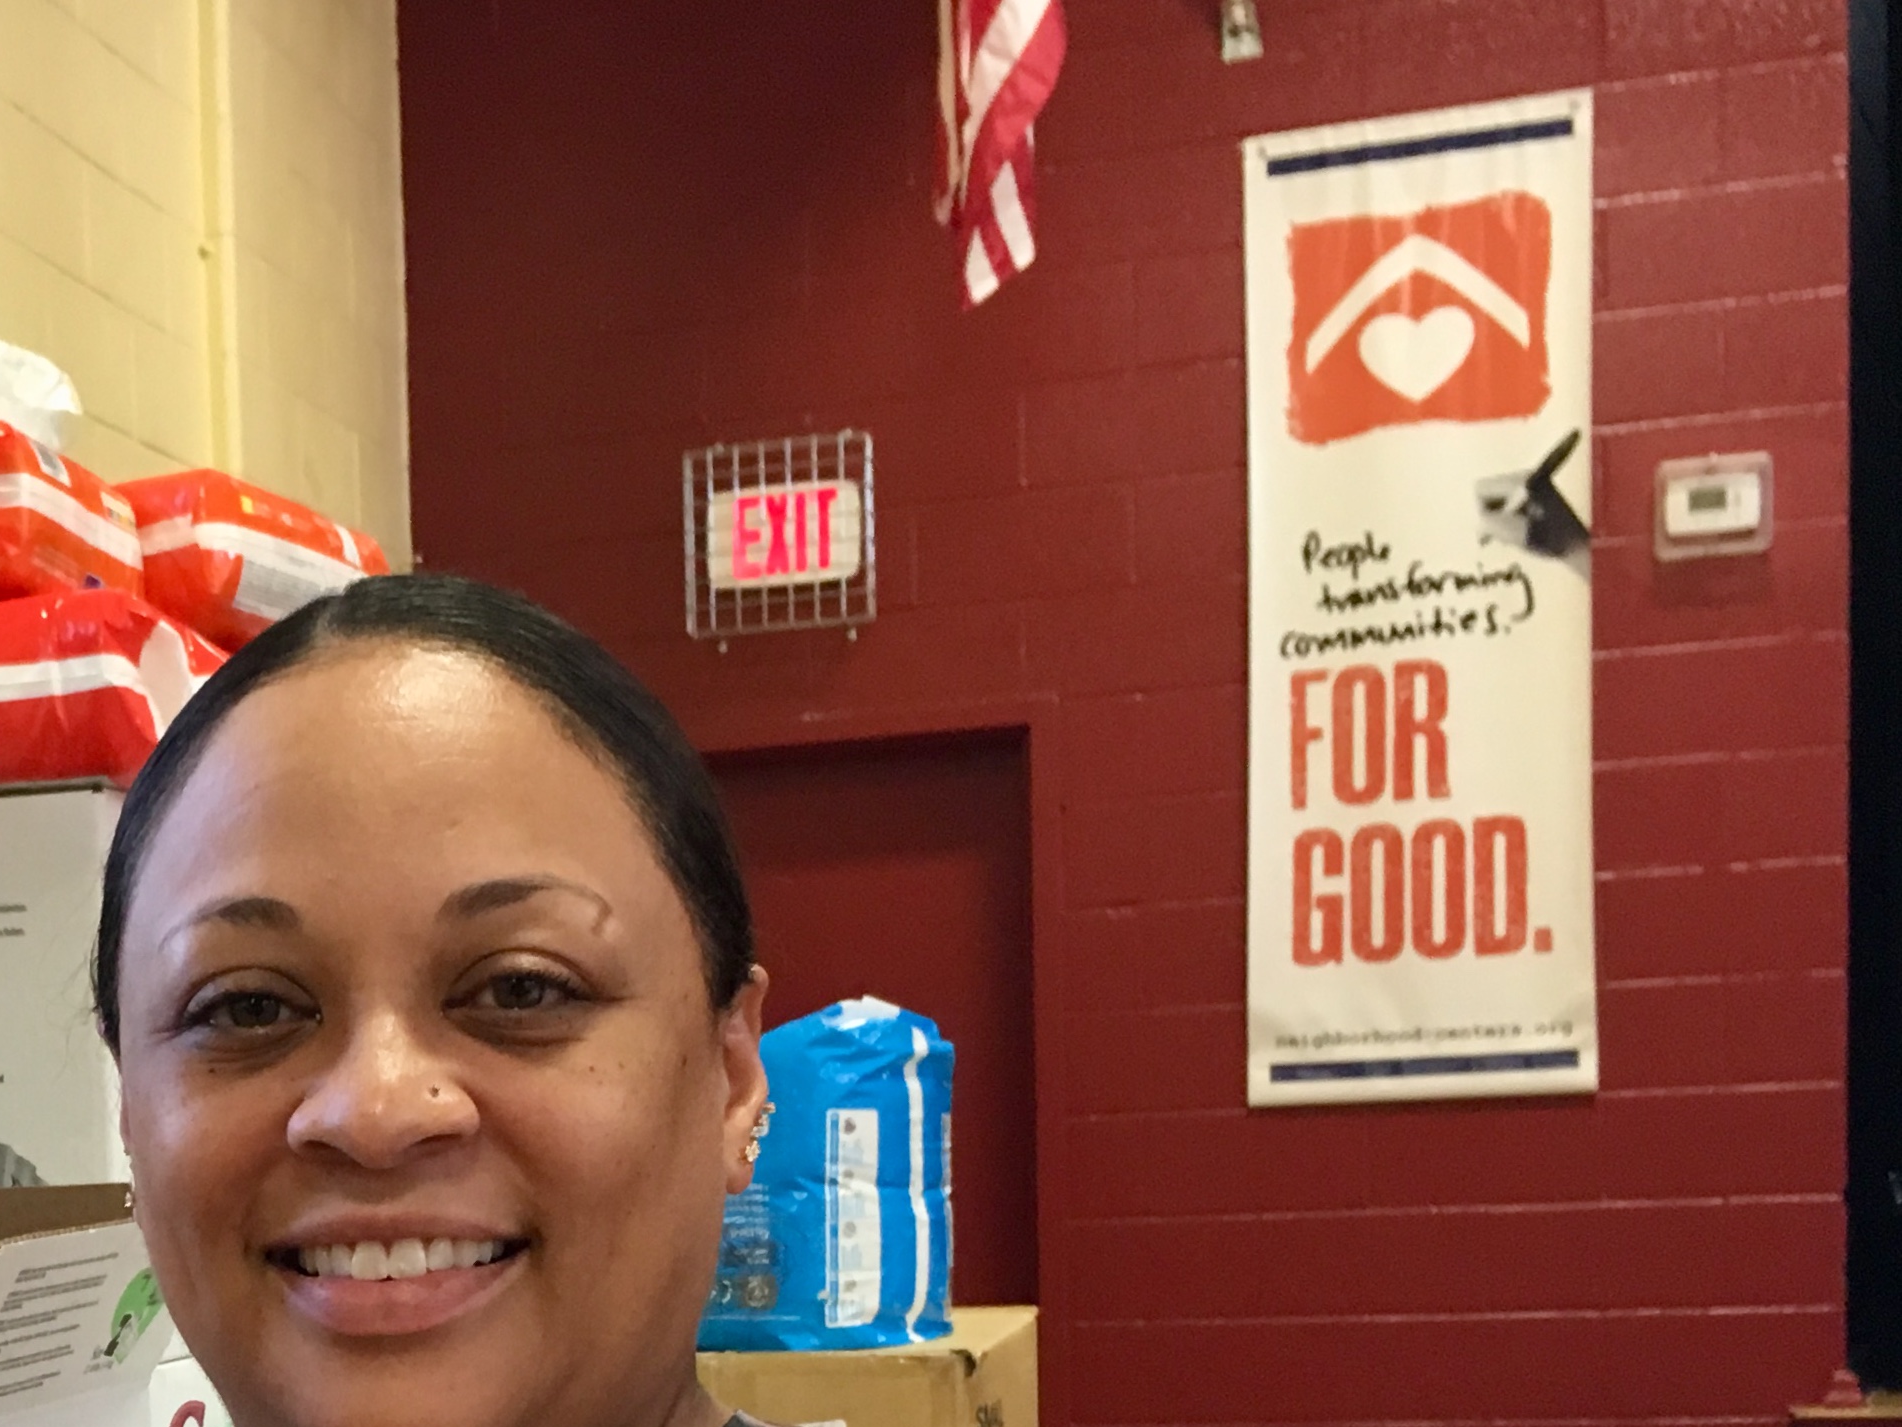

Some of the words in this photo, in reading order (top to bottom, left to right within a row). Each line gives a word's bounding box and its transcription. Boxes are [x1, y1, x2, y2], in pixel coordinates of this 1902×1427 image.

[733, 488, 837, 580] EXIT
[1302, 530, 1391, 580] People
[1318, 561, 1535, 622] transforming
[1290, 659, 1451, 811] FOR
[1292, 814, 1553, 967] GOOD.
